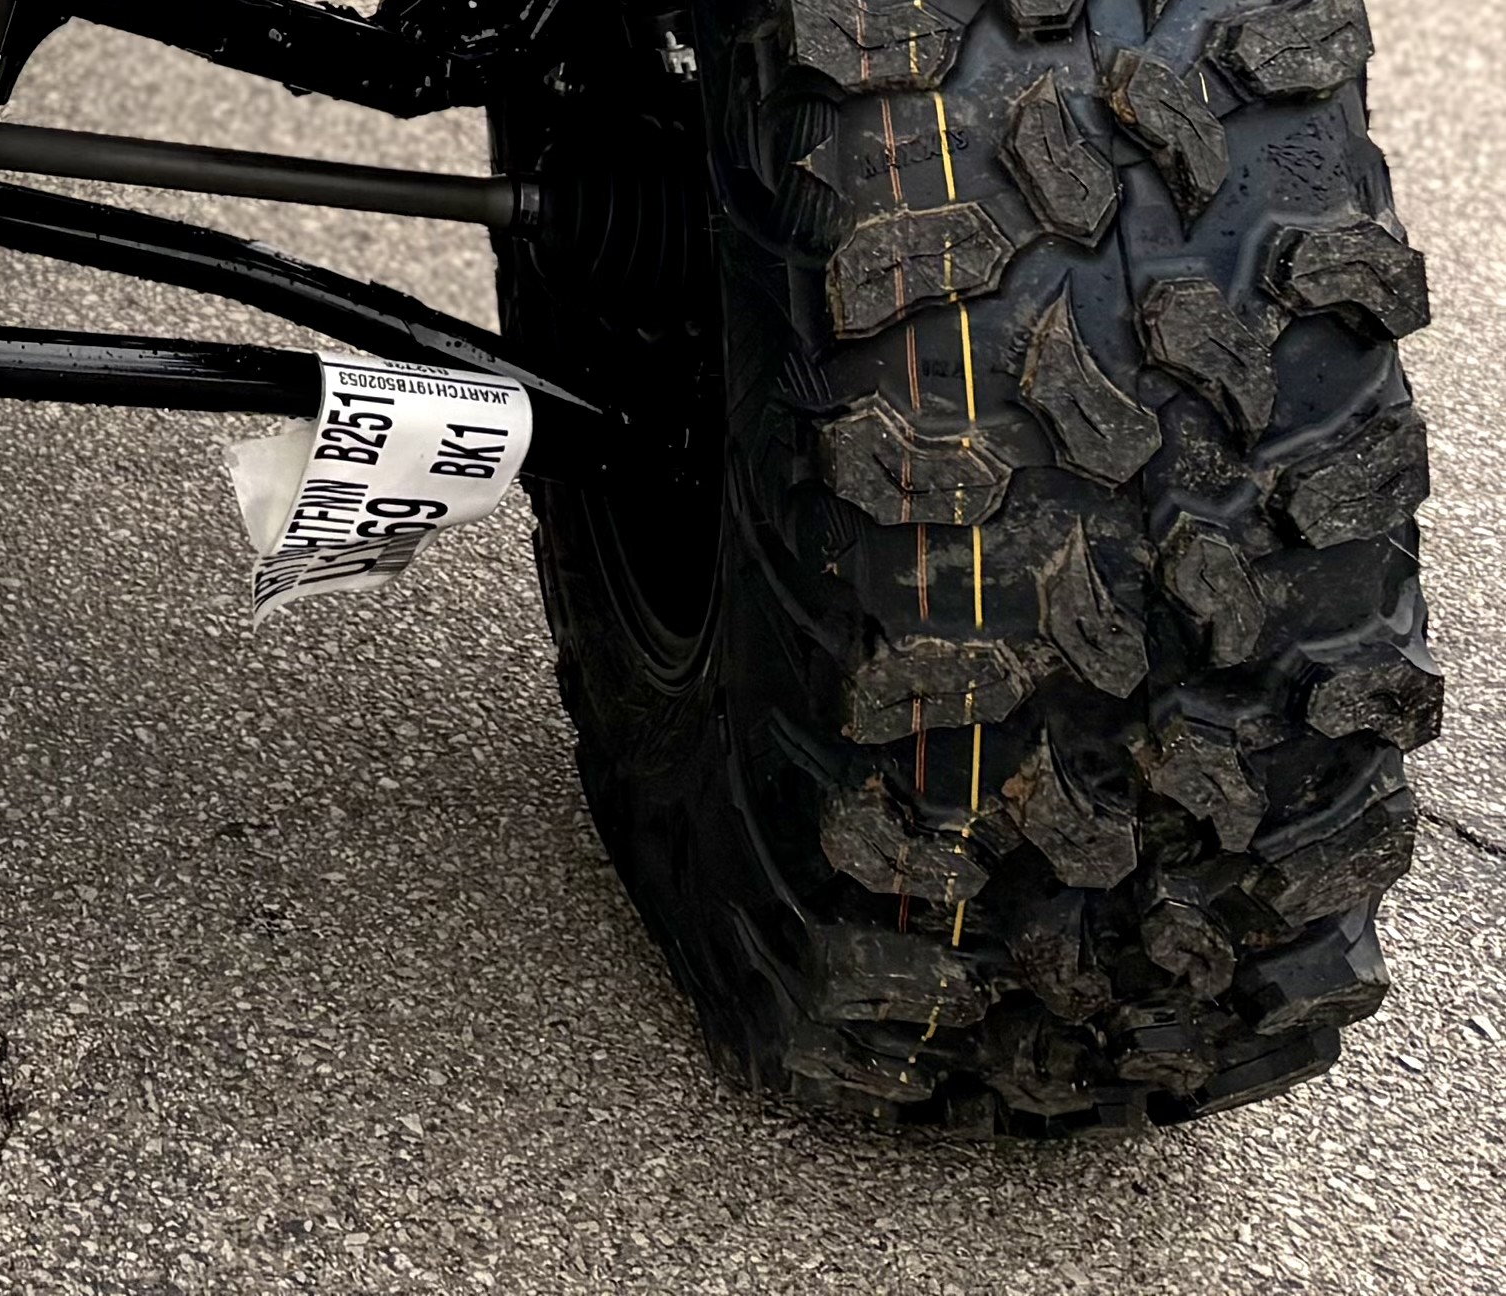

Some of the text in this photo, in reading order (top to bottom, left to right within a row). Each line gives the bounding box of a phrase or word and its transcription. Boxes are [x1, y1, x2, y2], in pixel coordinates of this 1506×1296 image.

[337, 370, 511, 406] JKARTCH19TB502053
[314, 390, 396, 466] B251
[429, 423, 509, 480] BK1
